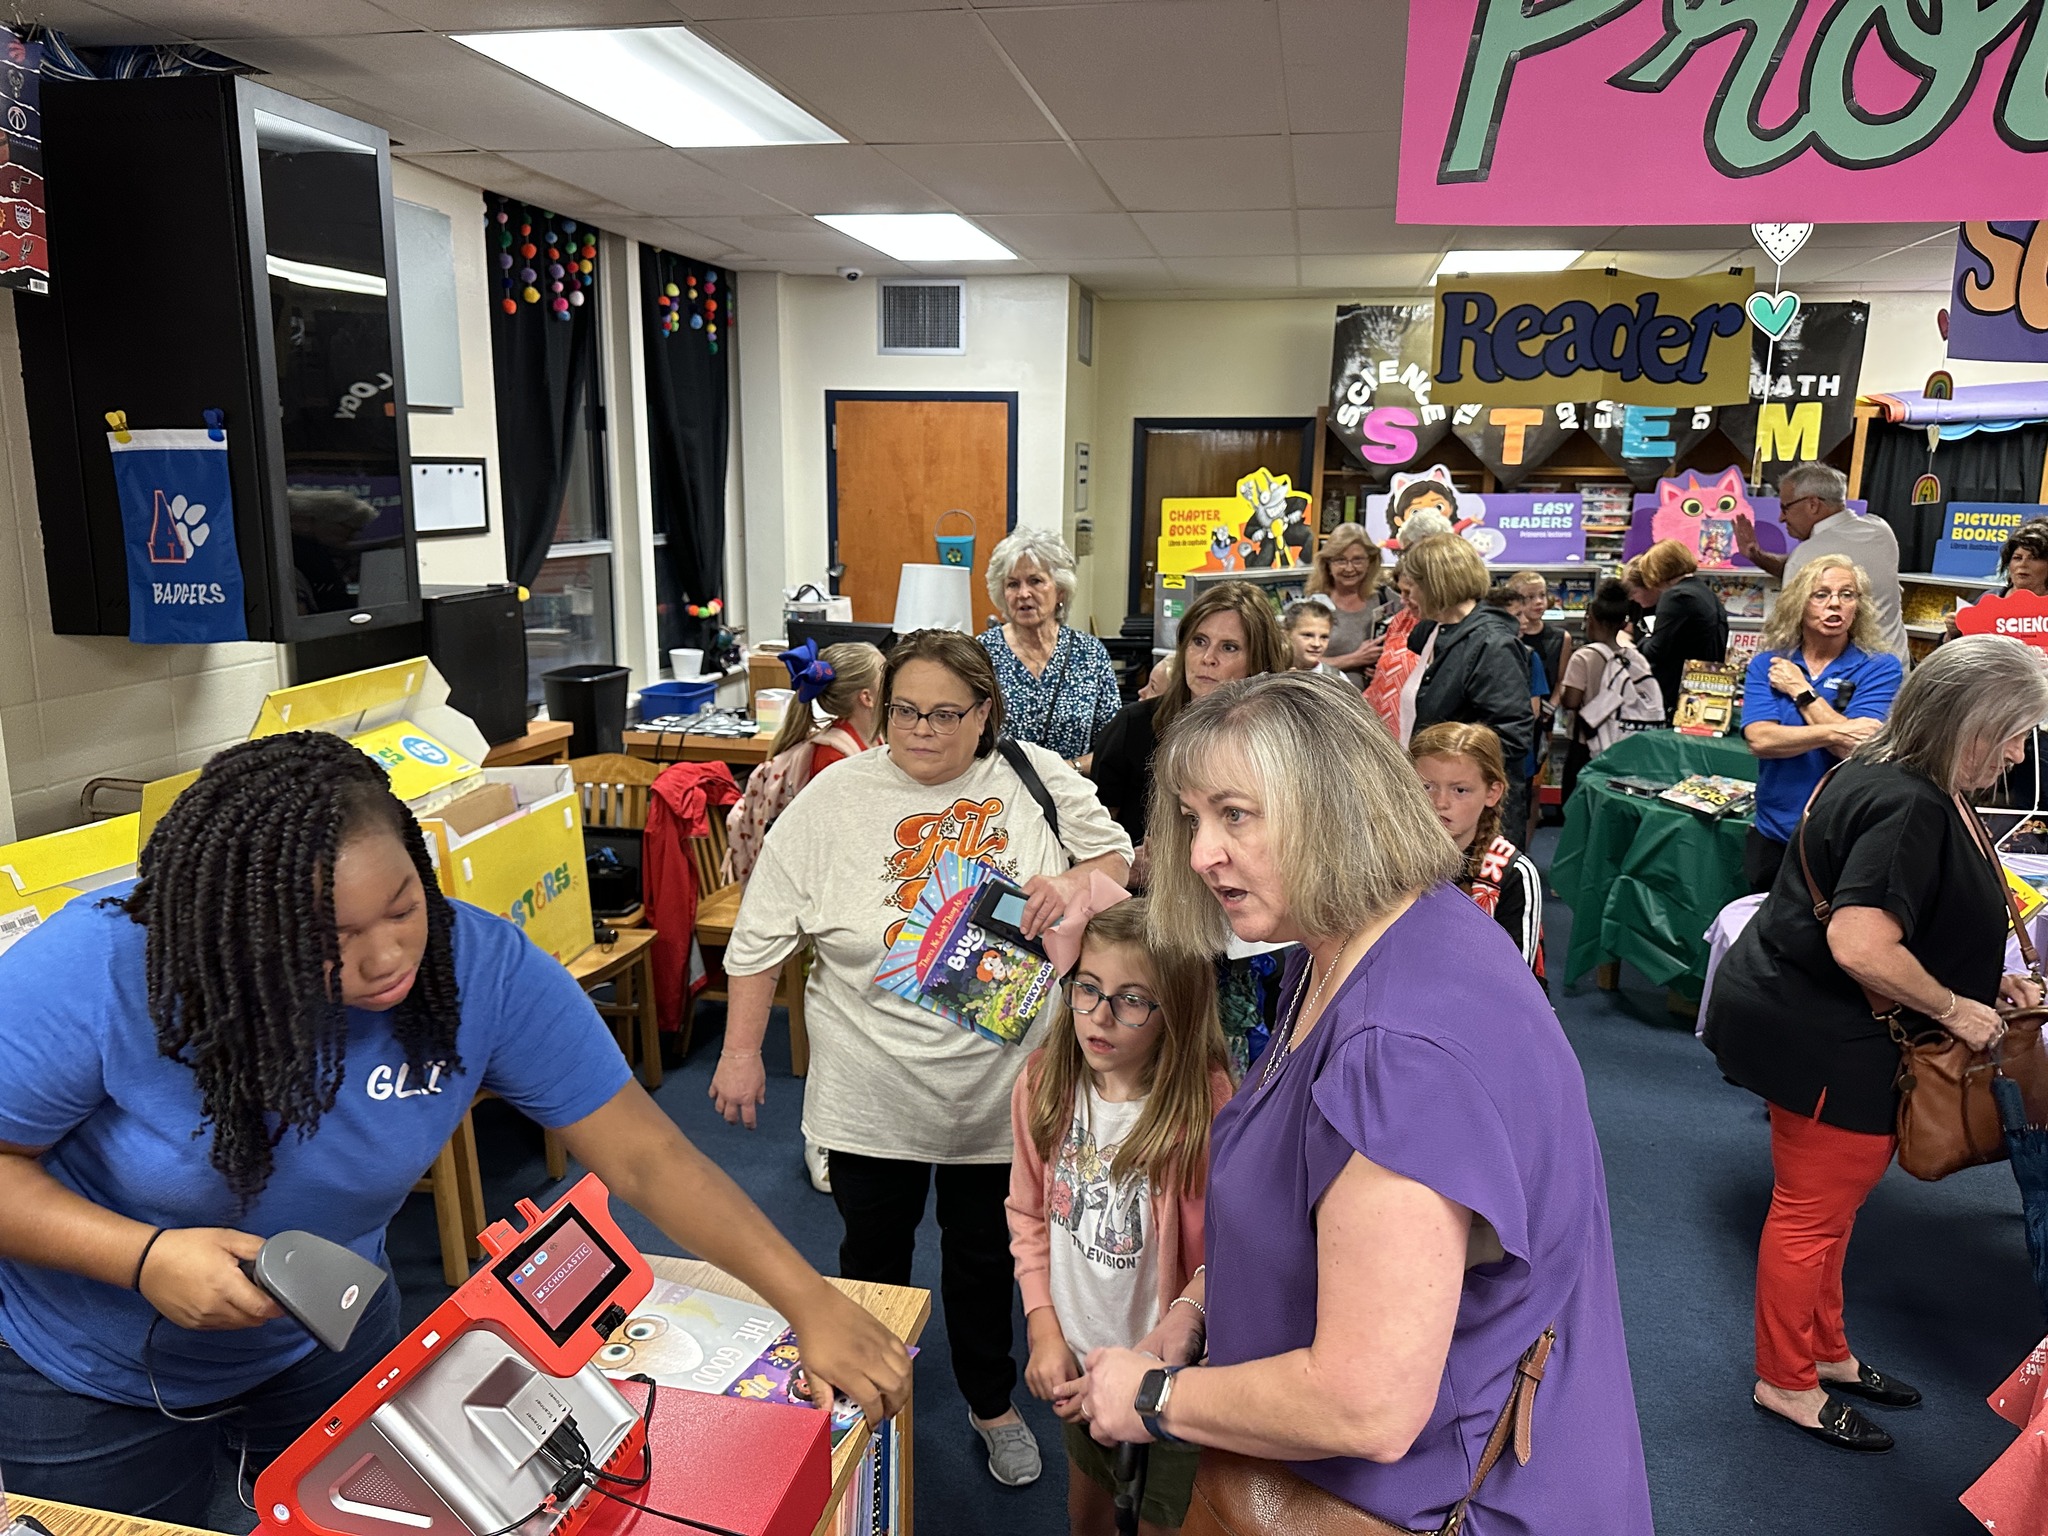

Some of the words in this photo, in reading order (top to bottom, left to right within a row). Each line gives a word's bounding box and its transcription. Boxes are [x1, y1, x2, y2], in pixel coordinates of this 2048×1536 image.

[1434, 291, 1746, 384] Reader
[1336, 360, 1447, 428] SCIENCE
[1169, 510, 1221, 522] CHAPTER
[1532, 502, 1575, 515] EASY
[1499, 516, 1573, 529] READERS
[1953, 512, 2022, 527] PICTURE
[1169, 524, 1207, 537] BOOKS
[1951, 527, 2009, 543] BOOKS
[152, 582, 226, 605] BADGERS
[1675, 782, 1731, 805] ROCKS
[1017, 983, 1042, 1016] BARKY
[1072, 1234, 1137, 1270] TELEVISION
[541, 1245, 590, 1294] SCHOLASTIC
[732, 1316, 775, 1344] THE
[691, 1346, 744, 1387] GOOD
[535, 1399, 554, 1419] Scanner
[548, 1392, 563, 1408] Power
[526, 1412, 543, 1430] Drawer
